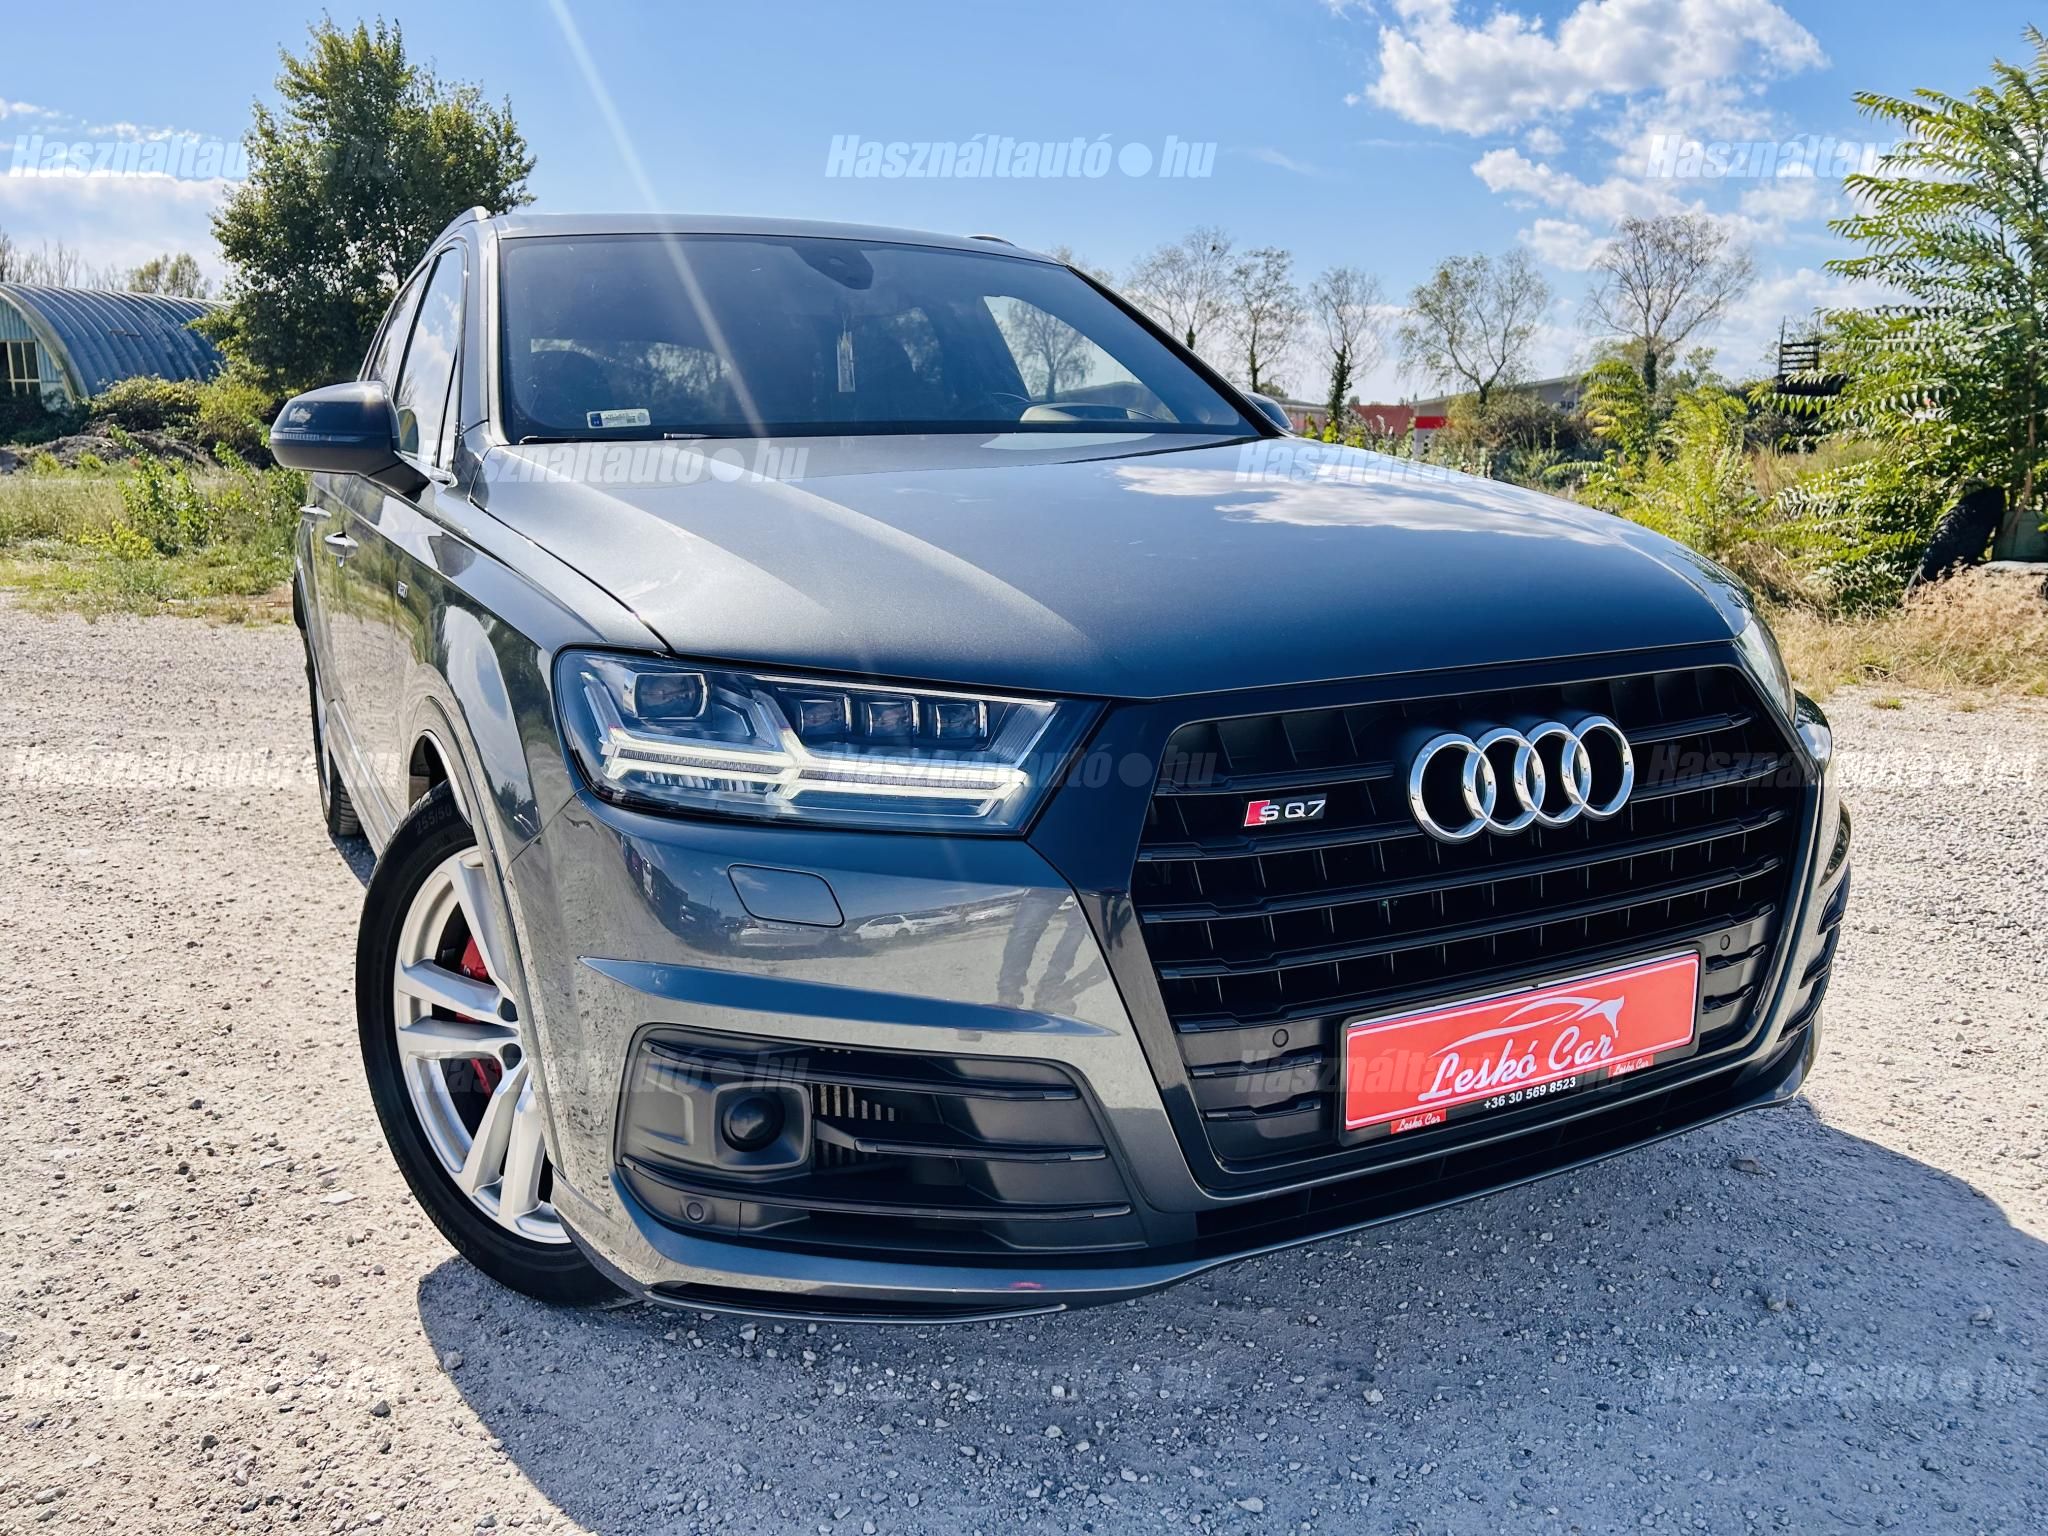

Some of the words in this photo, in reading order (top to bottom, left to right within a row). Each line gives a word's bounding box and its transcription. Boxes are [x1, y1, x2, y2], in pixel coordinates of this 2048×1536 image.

[1417, 1038, 1537, 1102] Leskó
[1548, 1025, 1613, 1070] Car
[1613, 1060, 1635, 1076] Leskó
[1635, 1057, 1649, 1070] Car
[1483, 1095, 1506, 1110] +36
[1508, 1090, 1523, 1104] 30
[1526, 1083, 1547, 1100] 569
[1549, 1076, 1577, 1094] 8523
[1396, 1116, 1423, 1132] Leskó
[1424, 1112, 1441, 1125] Car
